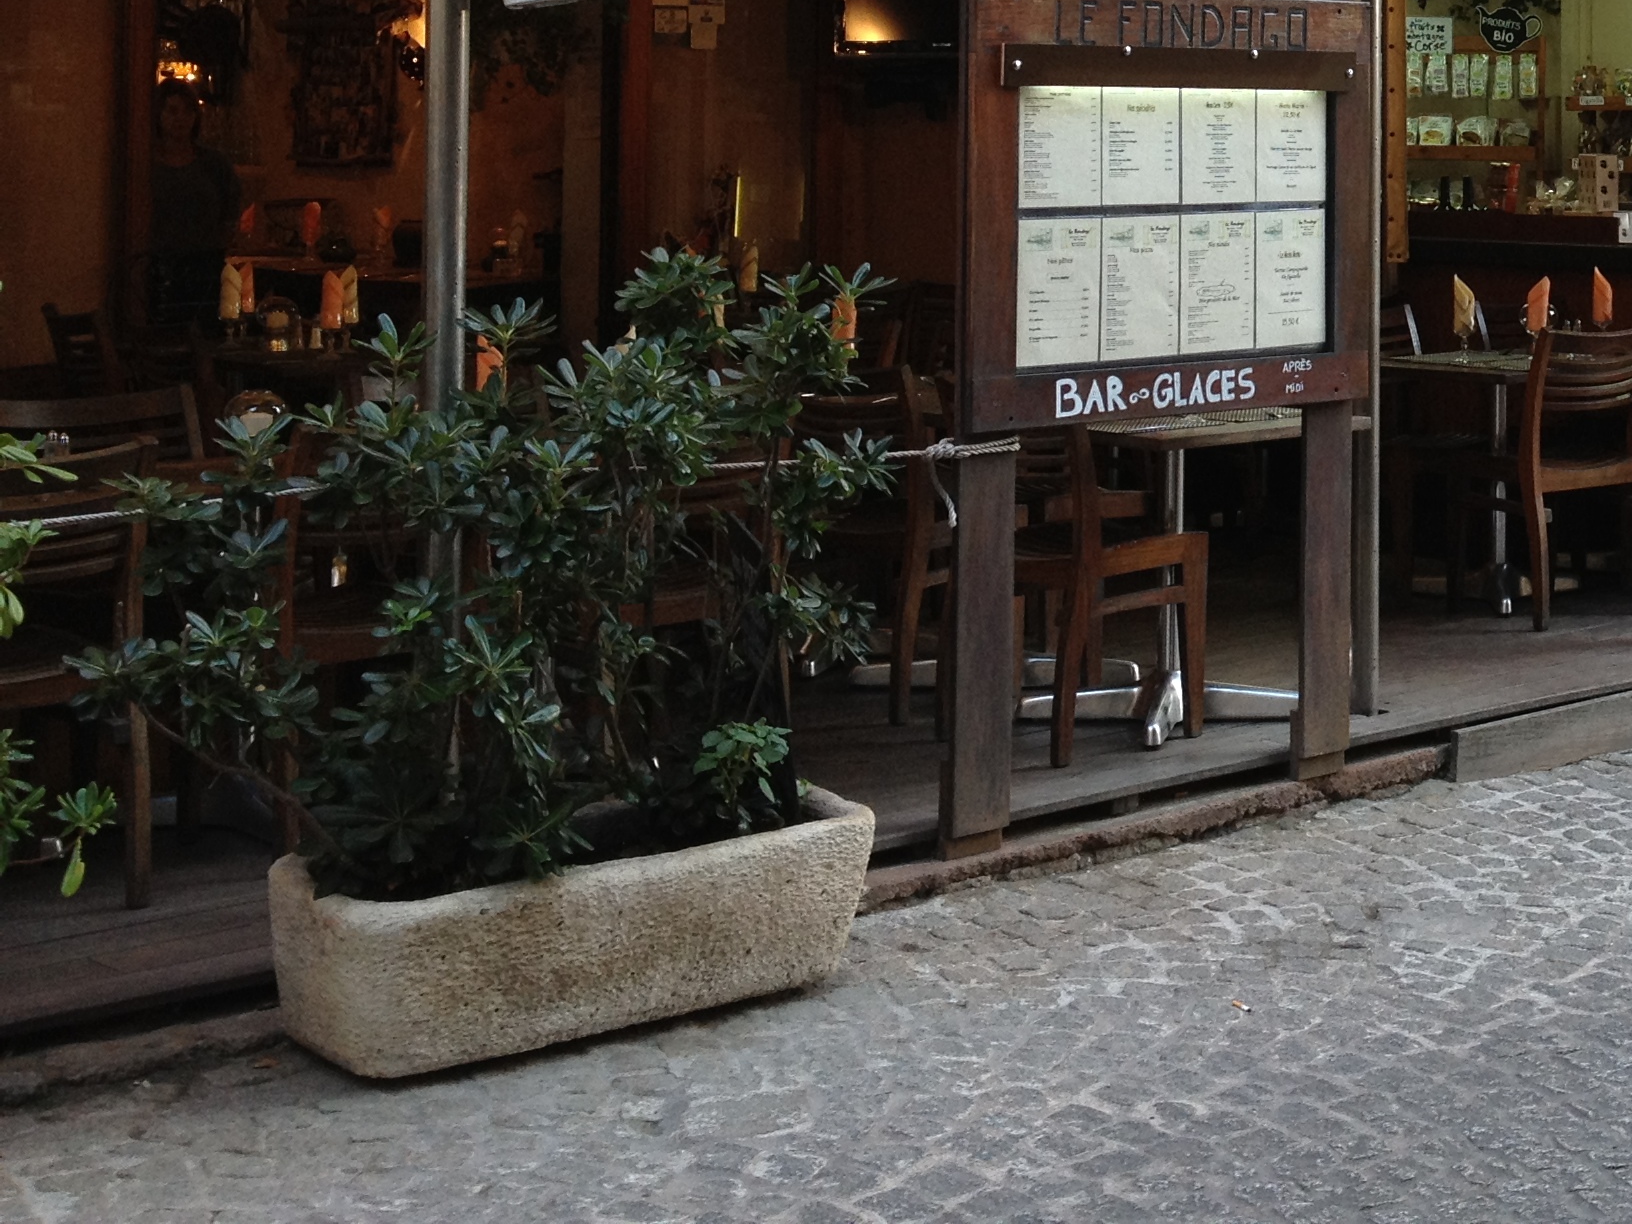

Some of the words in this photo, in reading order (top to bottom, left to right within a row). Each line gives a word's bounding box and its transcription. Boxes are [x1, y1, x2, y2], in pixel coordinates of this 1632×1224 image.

[1119, 0, 1308, 51] FONDAGO
[1055, 375, 1129, 419] BAR
[1152, 366, 1257, 410] GLACES
